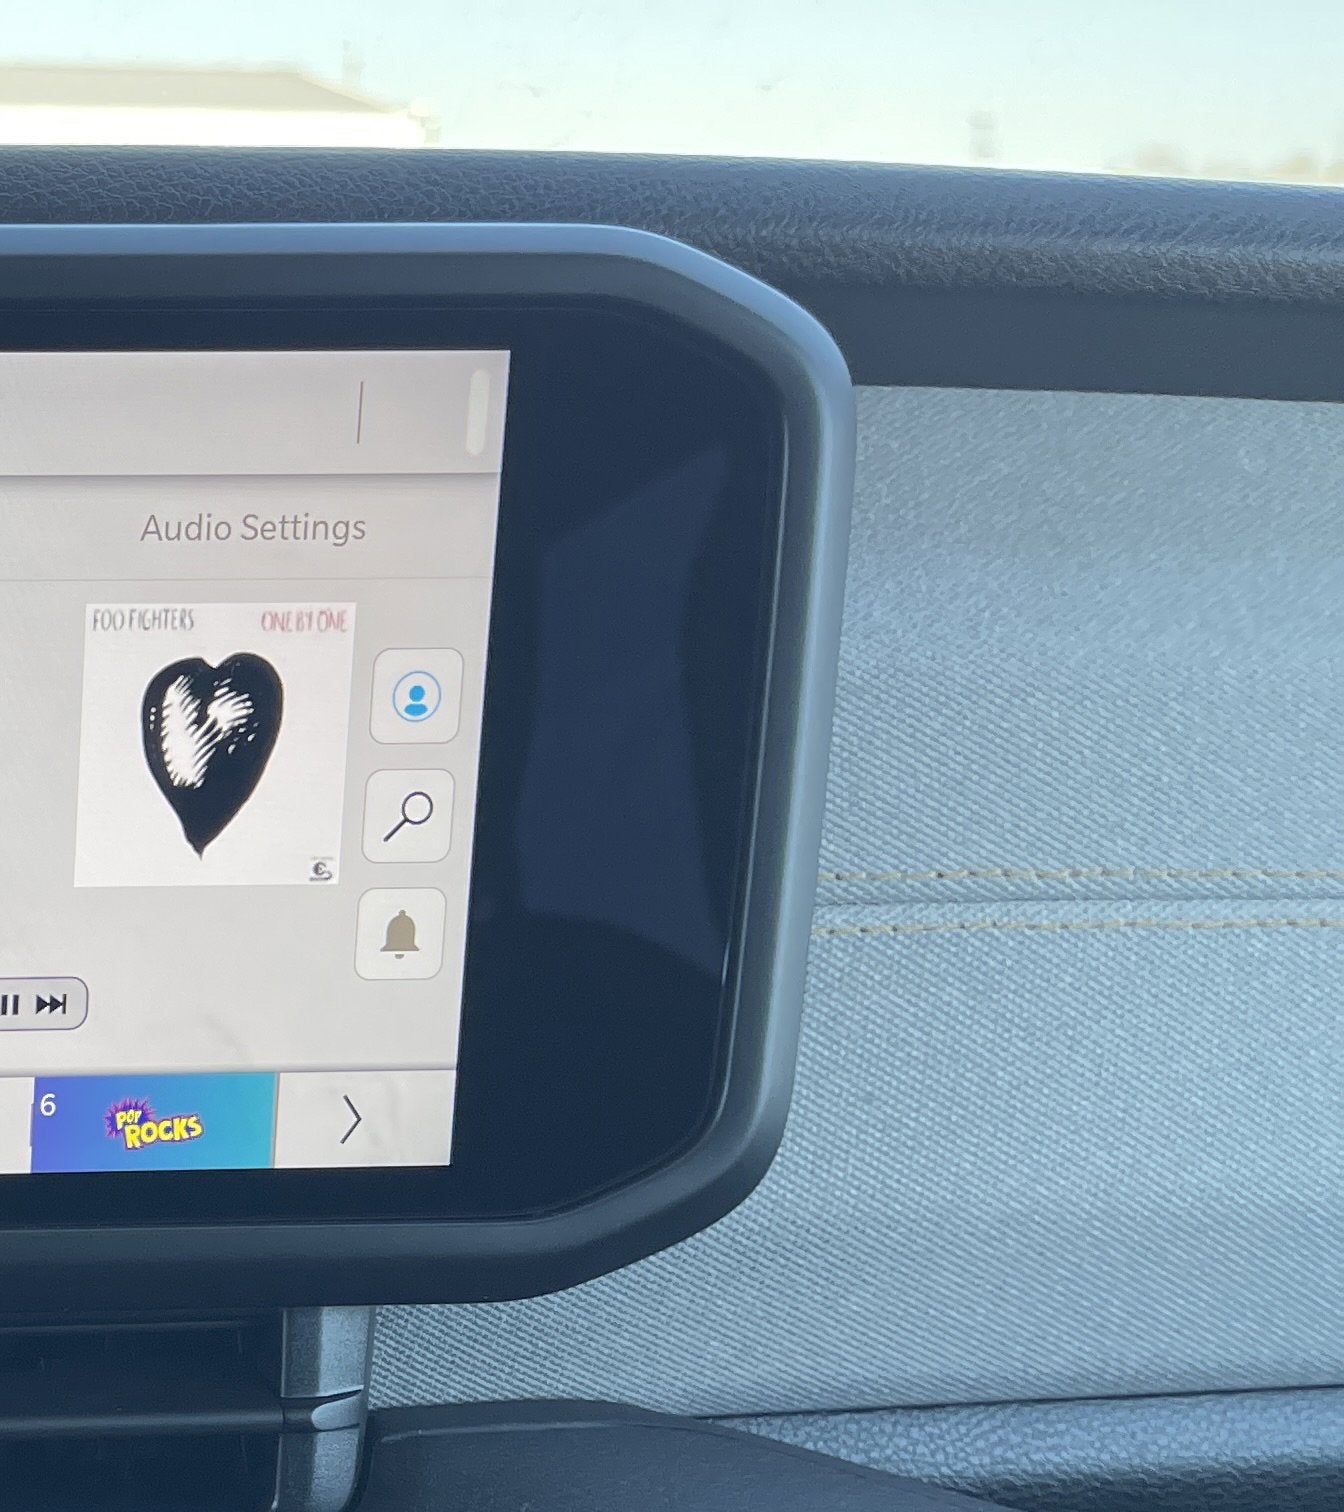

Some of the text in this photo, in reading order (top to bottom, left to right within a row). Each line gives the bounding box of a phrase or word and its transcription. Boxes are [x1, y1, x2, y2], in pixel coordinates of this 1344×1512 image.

[139, 513, 367, 546] Audio Settings
[92, 608, 195, 632] FOO FIGHTERS
[262, 608, 348, 632] ONE BY ONE
[39, 1094, 57, 1117] 6
[115, 1108, 143, 1131] POP
[124, 1115, 203, 1149] ROCKS
